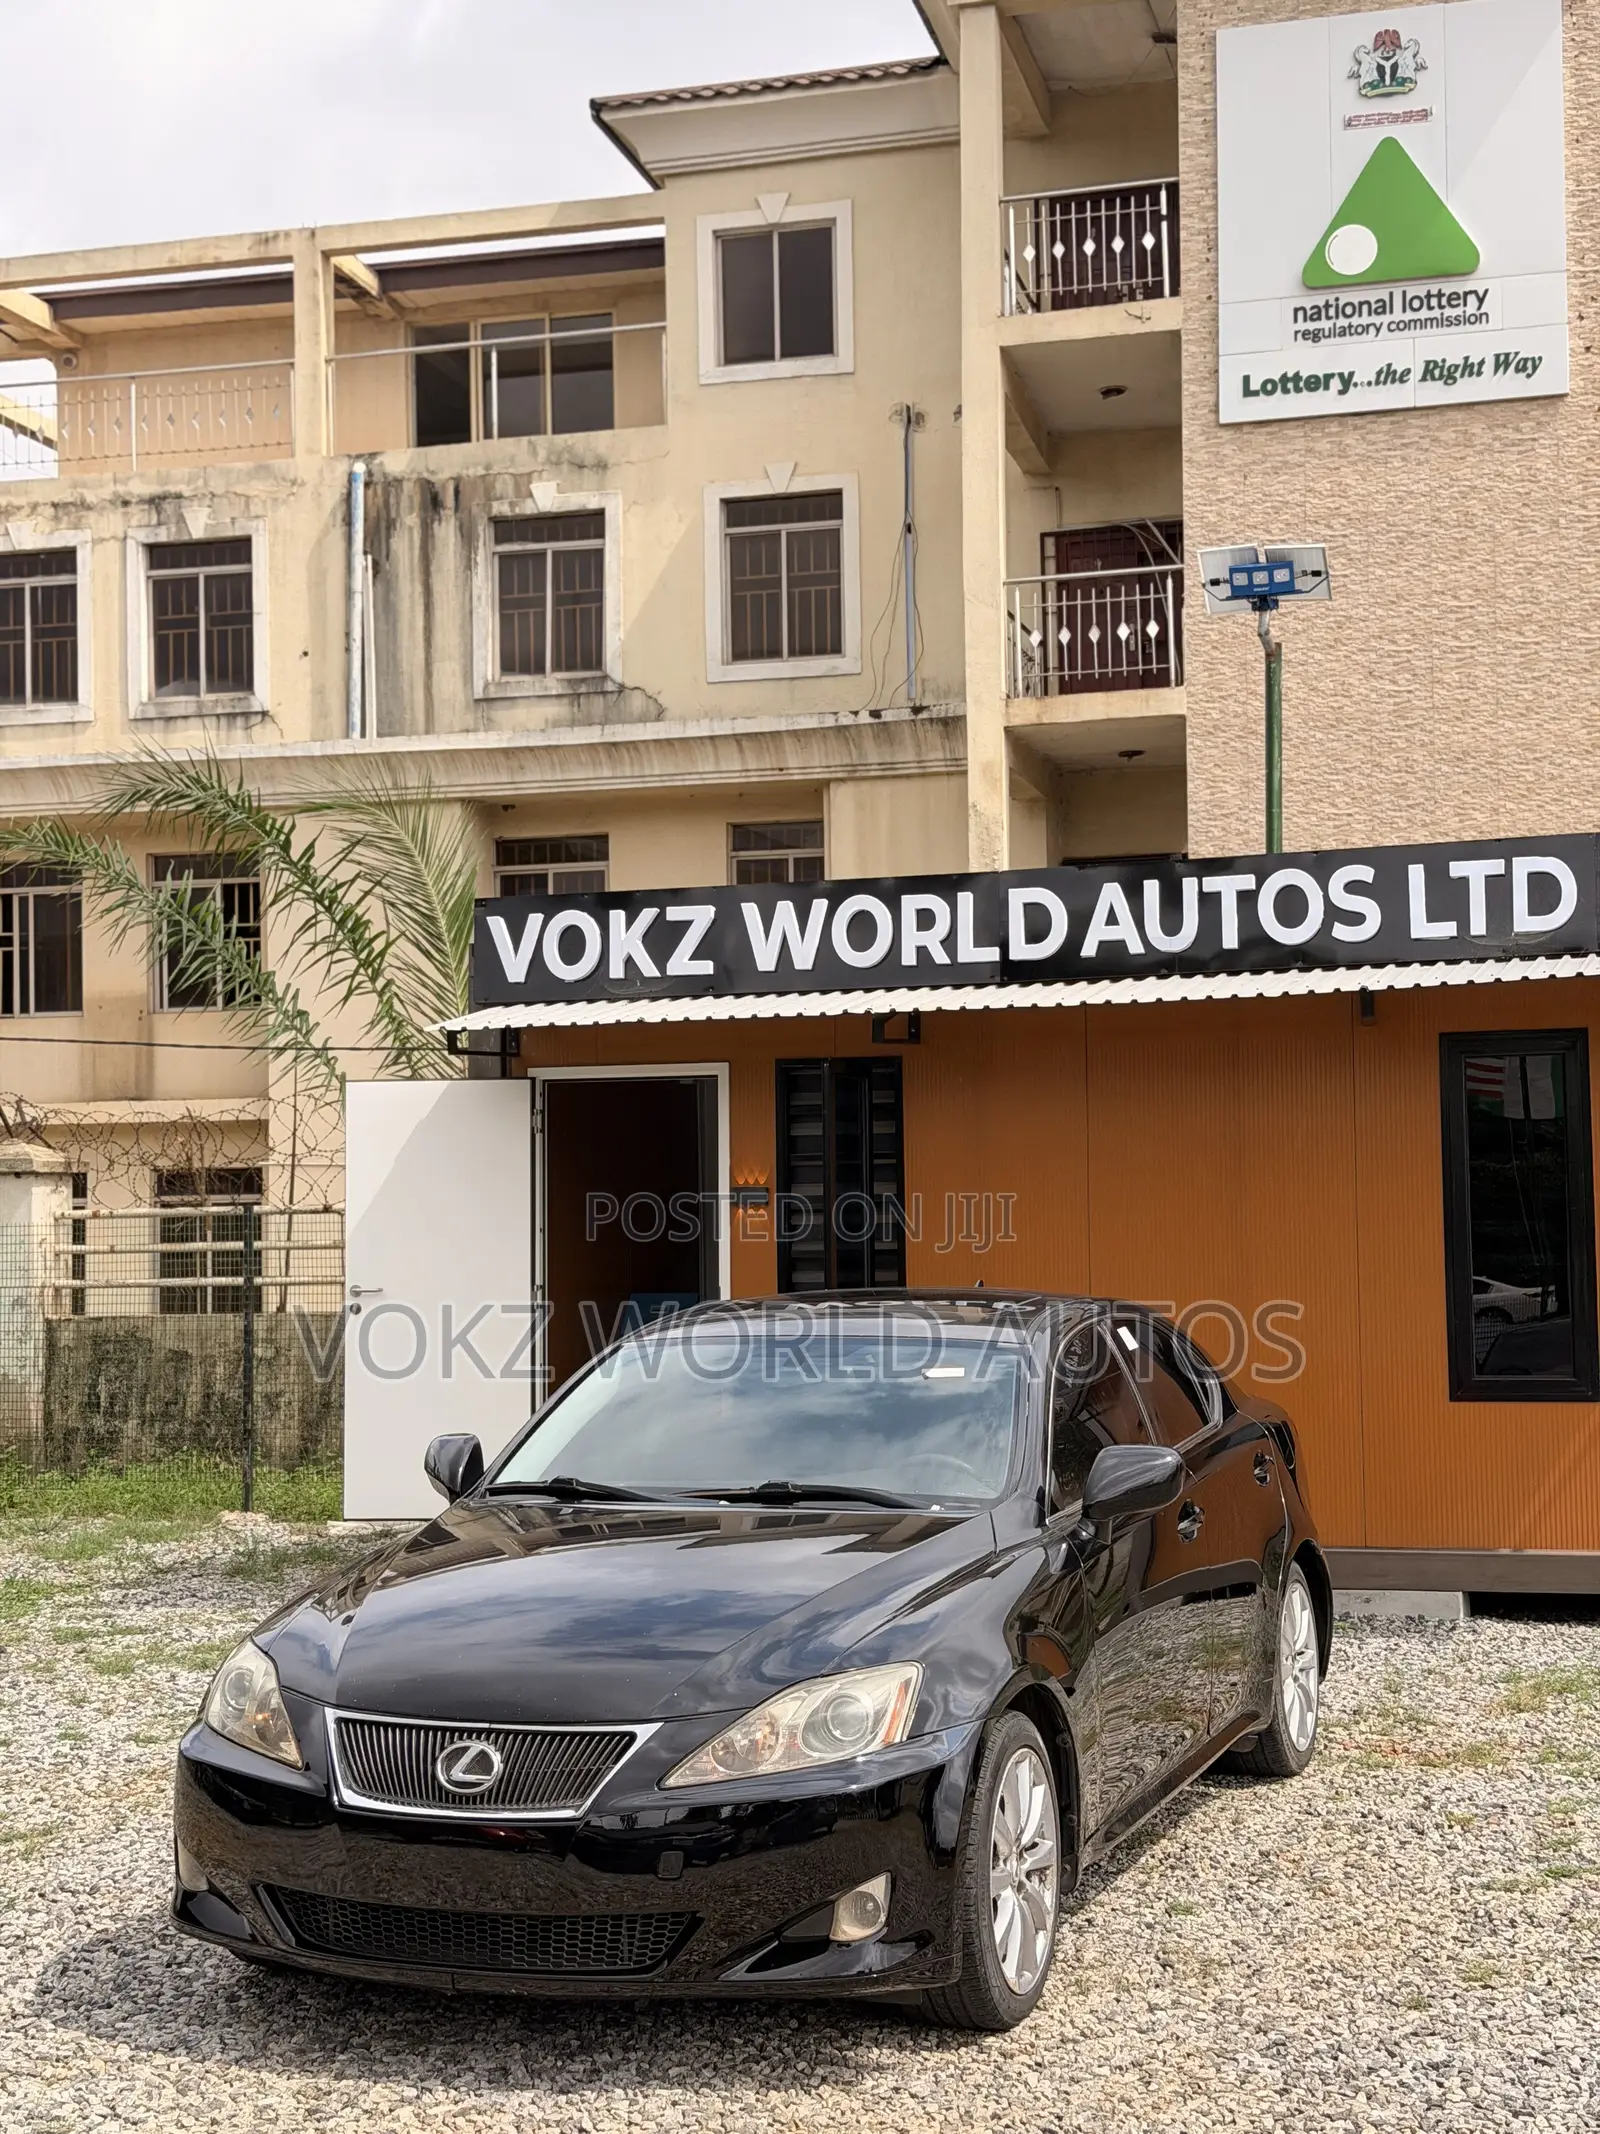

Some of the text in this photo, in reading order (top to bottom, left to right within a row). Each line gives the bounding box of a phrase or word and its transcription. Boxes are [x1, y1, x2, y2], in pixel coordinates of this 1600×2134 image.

[1293, 287, 1490, 324] national lottery
[1293, 310, 1490, 344] regulatory commission
[1418, 355, 1486, 386] Right
[1492, 350, 1543, 379] Way
[486, 855, 1578, 984] VOKZ WORLD AUTOS LTD
